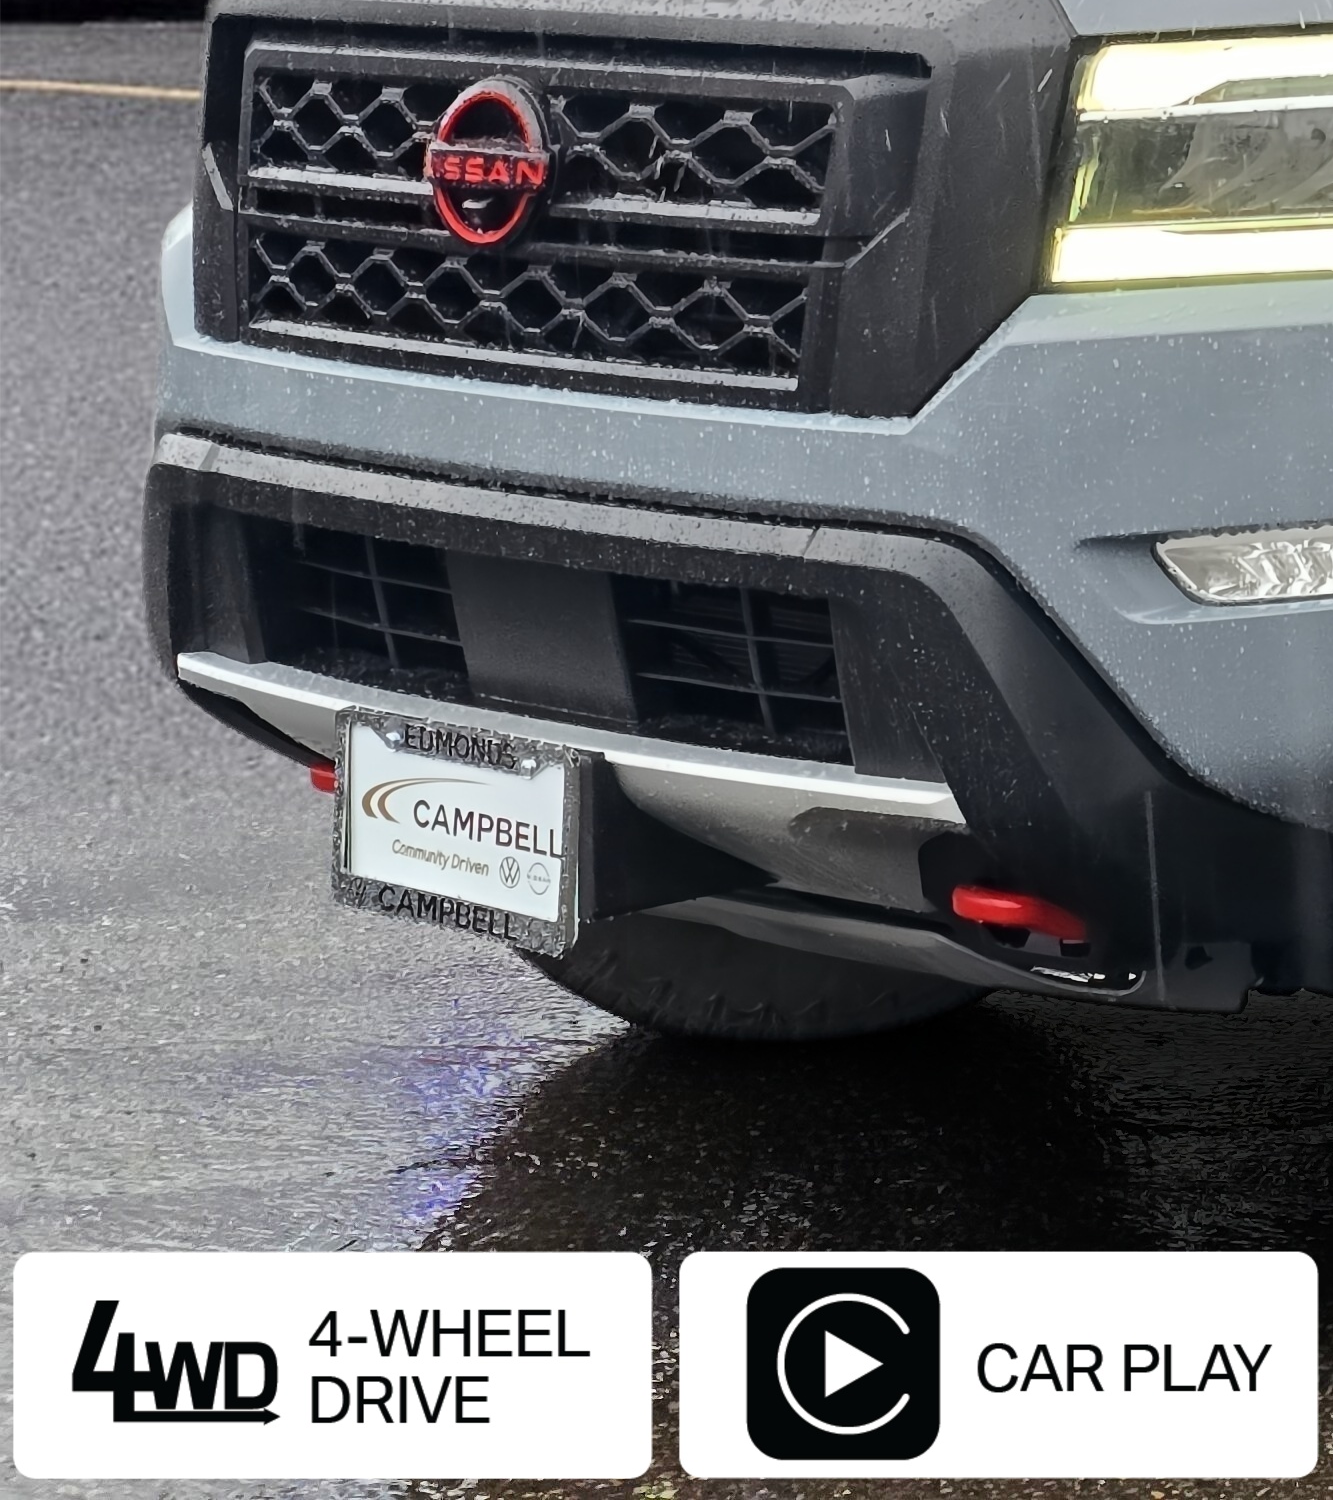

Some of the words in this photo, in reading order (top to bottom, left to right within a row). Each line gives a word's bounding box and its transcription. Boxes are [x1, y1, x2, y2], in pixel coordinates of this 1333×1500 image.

[430, 154, 546, 186] SSAN
[413, 799, 566, 858] CAMPBELL
[391, 838, 450, 871] Community
[451, 853, 490, 877] Driven
[378, 884, 519, 941] CAMPBELL
